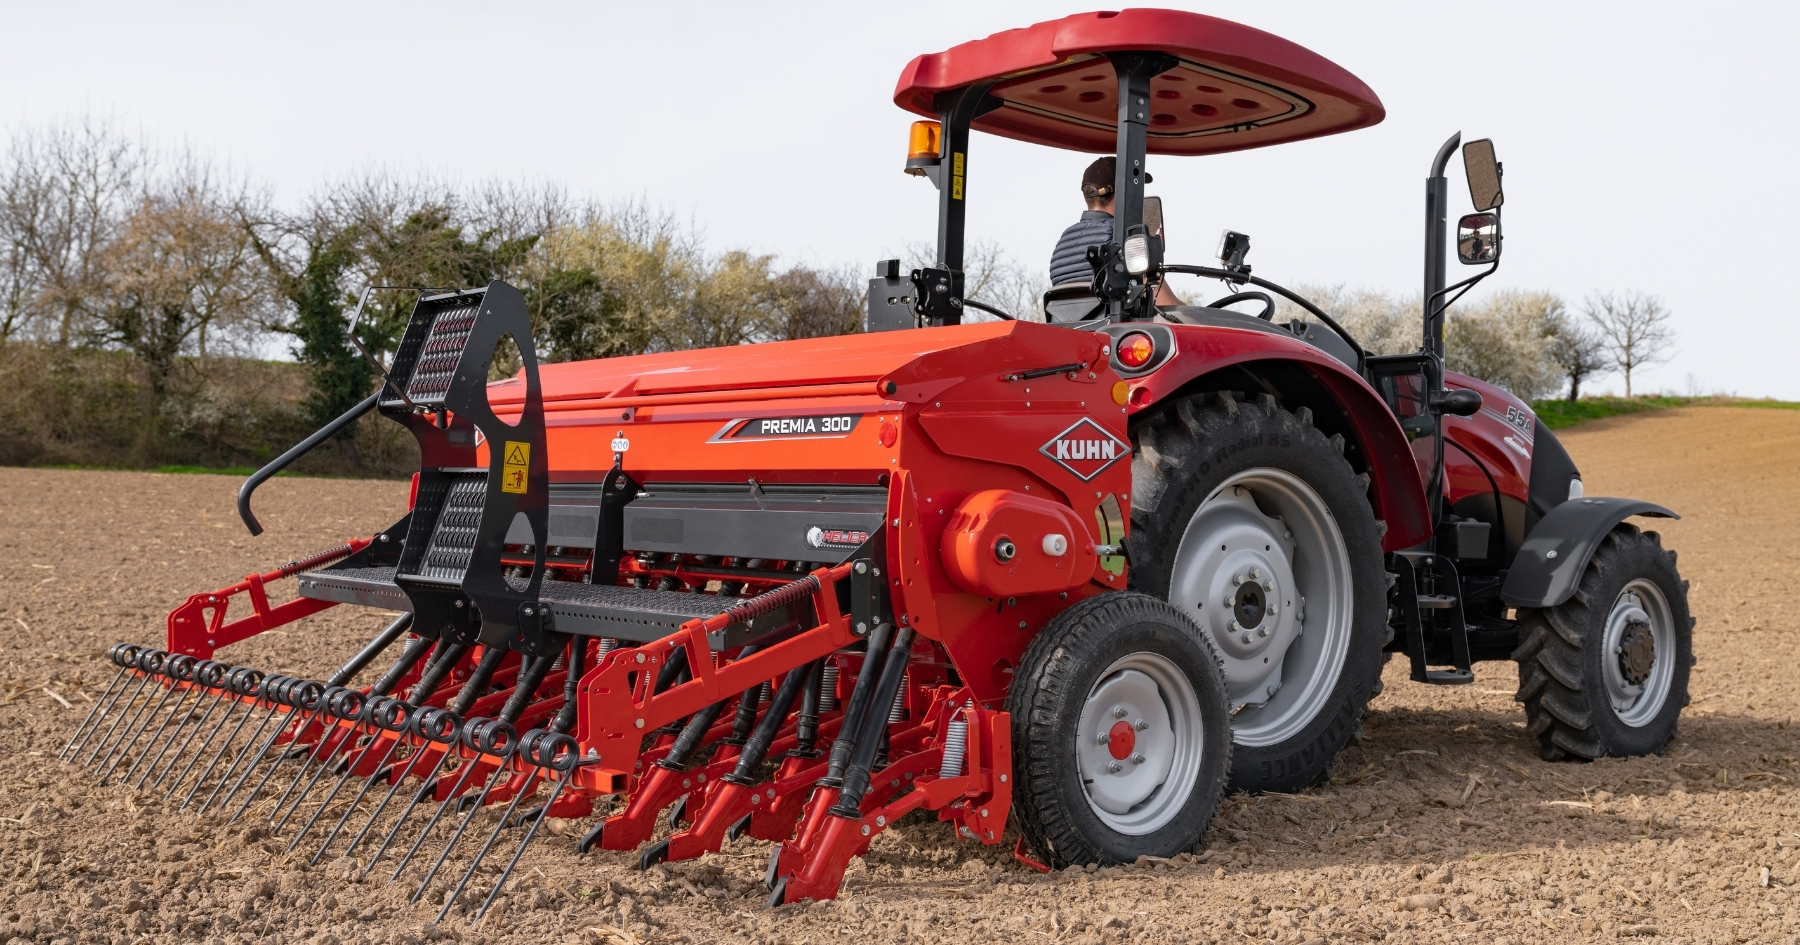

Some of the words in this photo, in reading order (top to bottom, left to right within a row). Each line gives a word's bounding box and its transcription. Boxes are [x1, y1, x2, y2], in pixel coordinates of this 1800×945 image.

[761, 418, 816, 434] PREMIA
[821, 417, 851, 432] 300
[1506, 405, 1532, 433] 55A
[1056, 439, 1115, 460] KUHN
[1214, 432, 1264, 465] Radial
[1267, 432, 1291, 448] 85
[823, 530, 868, 544] HELICA
[1261, 692, 1355, 783] ALLIANCE
